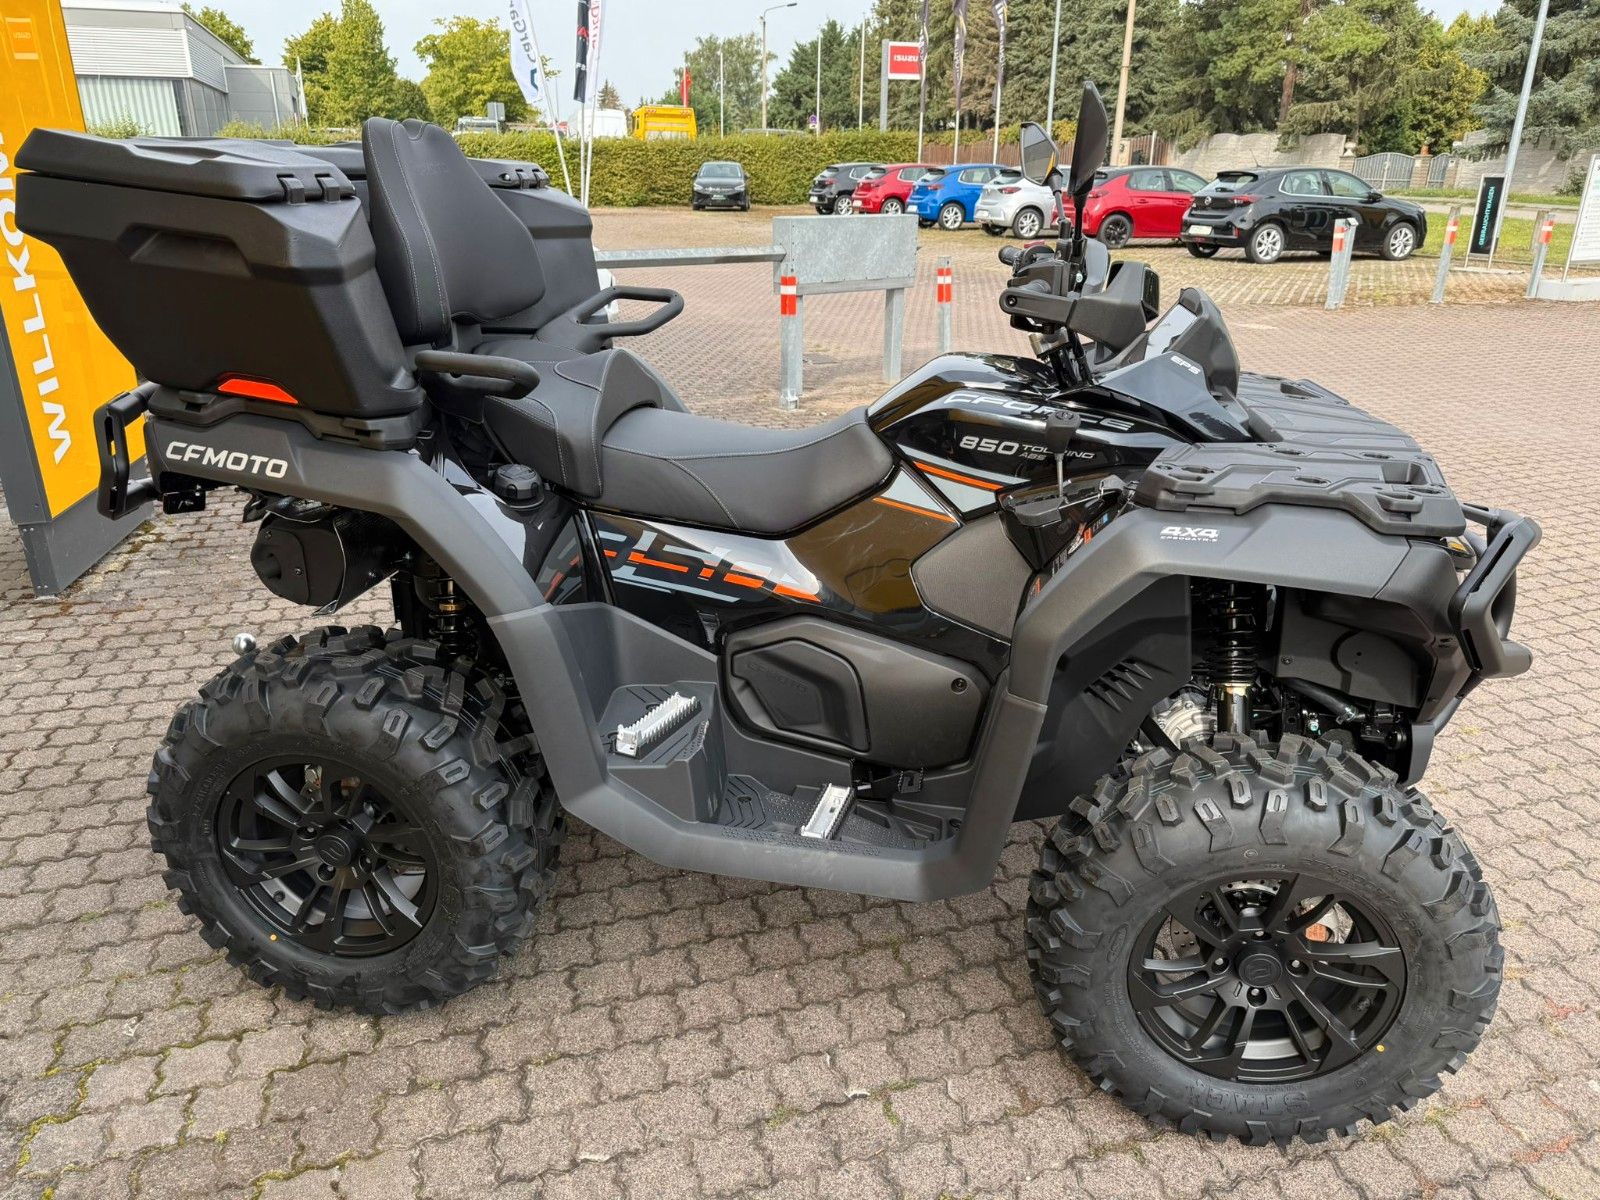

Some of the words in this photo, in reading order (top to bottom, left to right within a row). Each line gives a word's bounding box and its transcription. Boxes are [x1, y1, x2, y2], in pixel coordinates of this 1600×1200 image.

[893, 54, 918, 62] ISUZU
[1478, 186, 1496, 246] GEBRAUCHTWAGEN
[1170, 355, 1200, 374] EPS
[959, 435, 1019, 455] 850
[1022, 444, 1095, 459] TOUING
[1018, 452, 1047, 461] ABS
[165, 441, 288, 478] CFMOTO
